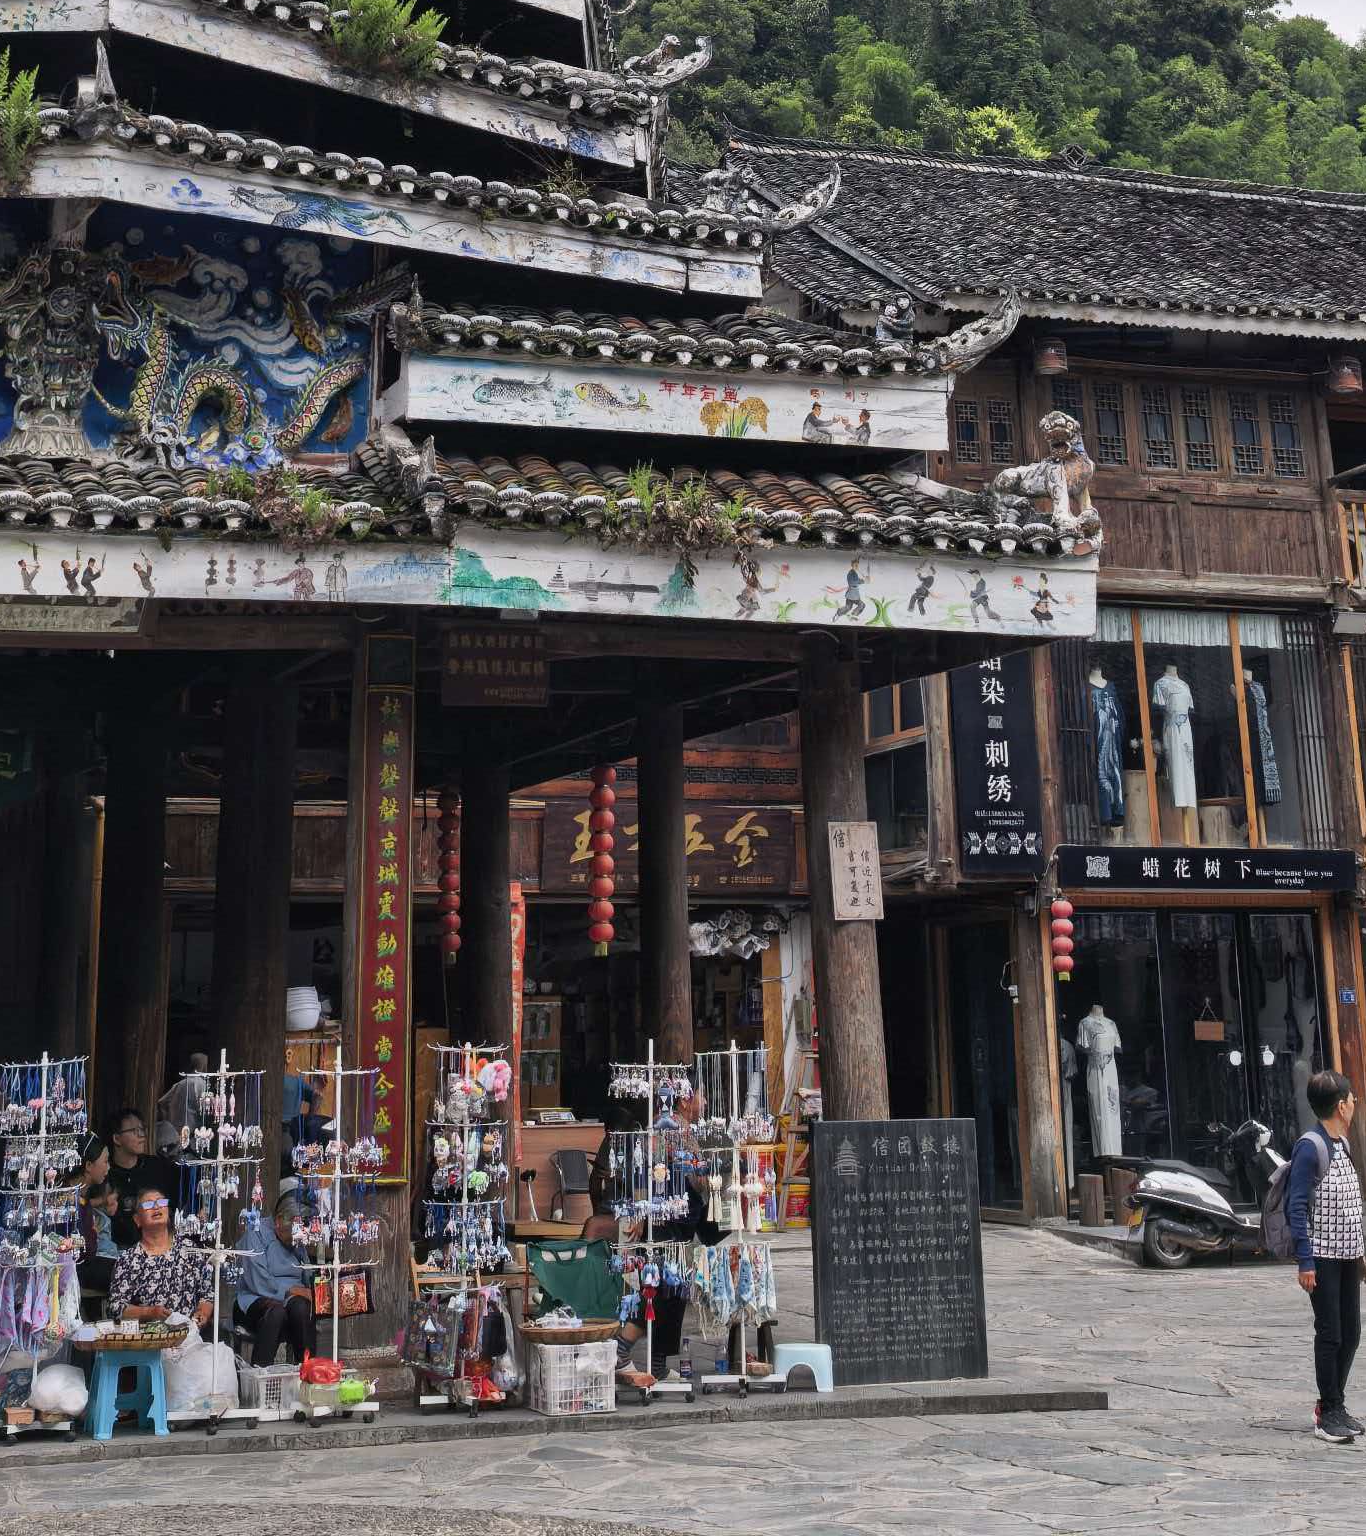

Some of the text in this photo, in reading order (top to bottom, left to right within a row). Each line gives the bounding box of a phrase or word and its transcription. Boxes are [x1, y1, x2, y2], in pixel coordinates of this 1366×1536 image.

[985, 740, 1011, 802] 刺绣
[833, 828, 845, 848] 信
[1142, 857, 1252, 879] 蜡花树下
